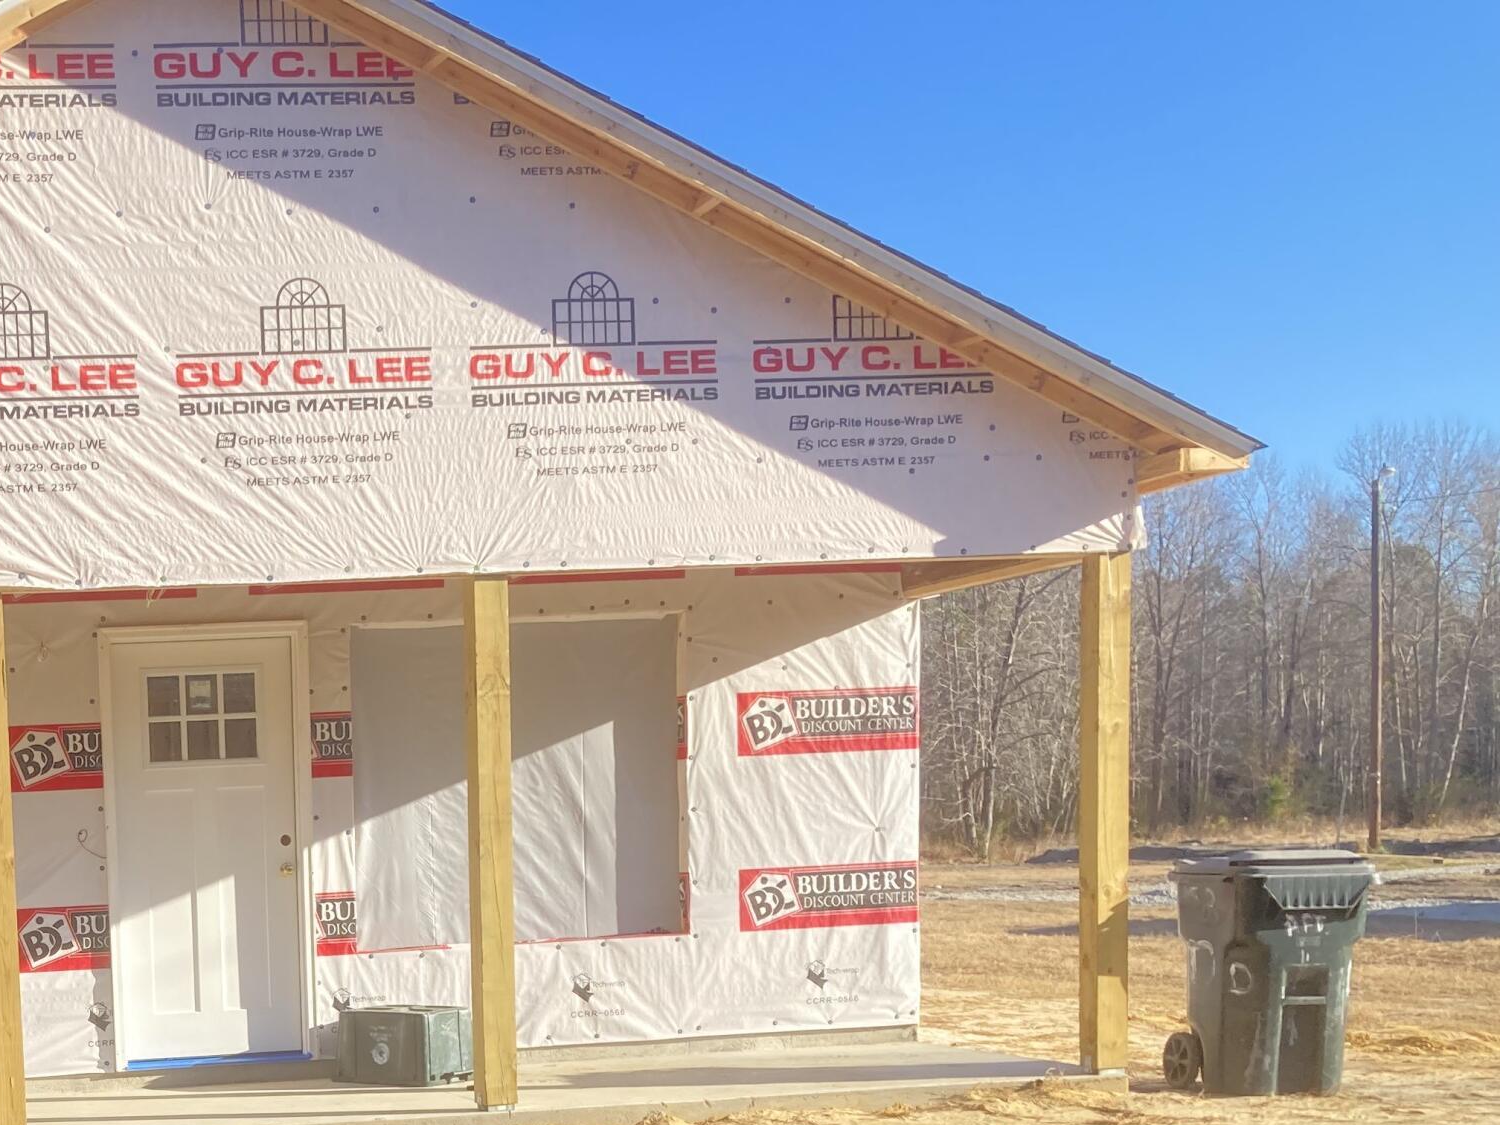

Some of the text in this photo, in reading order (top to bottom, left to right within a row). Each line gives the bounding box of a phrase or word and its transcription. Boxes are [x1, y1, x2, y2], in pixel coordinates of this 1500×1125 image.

[28, 54, 115, 79] LEE
[154, 52, 414, 79] GUY C. LEE
[157, 91, 415, 107] BUILDING MATERIALS
[55, 130, 83, 141] LWE
[218, 126, 383, 139] Grip-Rite House-Wrap LWE
[26, 152, 64, 162] Grade
[68, 152, 77, 161] D
[227, 148, 376, 160] ICC ESR # 3729, Grade D
[227, 169, 354, 180] MEETS ASTM E 2357
[520, 166, 601, 176] MEETS ASTM
[469, 350, 717, 380] GUY C. LEE
[753, 345, 981, 373] GUY C. LE
[51, 364, 138, 391] LEE
[176, 357, 432, 388] GUY C. LEE
[471, 387, 718, 407] BUILDING MATERIALS
[755, 380, 994, 400] BUILDING MATERIALS
[0, 403, 140, 420] MATERIALS
[179, 395, 433, 417] BUILDING MATERIALS
[529, 422, 686, 437] Grip-Rite House-Wrap LWE
[811, 414, 963, 429] Grip-Rite House-Wrap LWE
[238, 431, 400, 448] Grip-Rite House-Wrap LWE
[818, 436, 956, 448] ICC ESR # 3729, Grade D
[1089, 432, 1108, 440] ICC
[0, 441, 75, 453] House-Wrap
[79, 439, 107, 450] LWE
[796, 695, 915, 719] BUILDER'S
[801, 716, 915, 733] DISCOUNT CENTER
[797, 869, 916, 894] BUILDER'S
[803, 891, 915, 909] DISCOUNT CENTER
